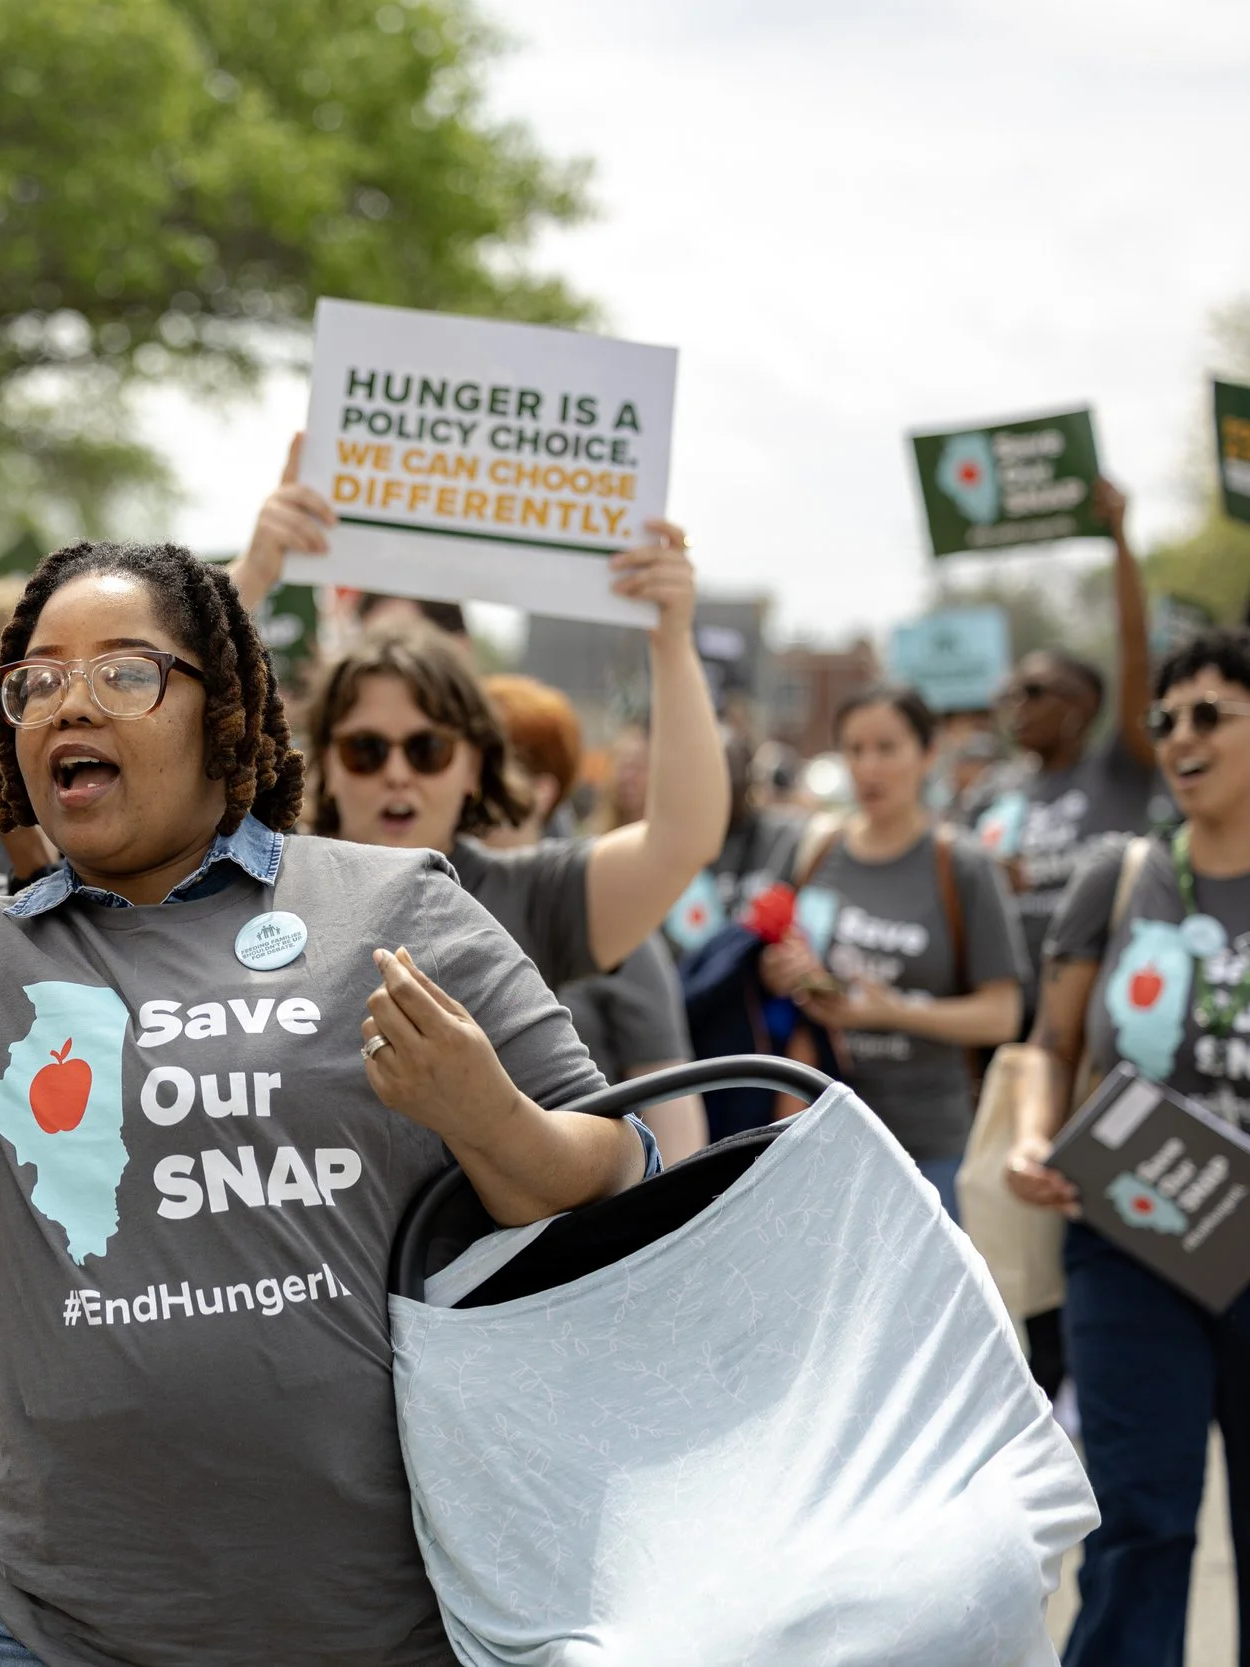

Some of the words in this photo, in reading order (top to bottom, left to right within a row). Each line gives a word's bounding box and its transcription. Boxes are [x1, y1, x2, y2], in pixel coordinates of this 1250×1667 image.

[346, 367, 541, 420] HUNGER
[559, 393, 598, 427] IS
[614, 402, 642, 433] A
[340, 407, 478, 446] POLICY
[488, 423, 638, 467] CHOICE.
[336, 440, 391, 471] WE
[402, 448, 478, 481] CAN
[488, 460, 637, 501] CHOOSE
[332, 475, 633, 538] DIFFERENTLY.
[241, 941, 270, 955] FEEDING
[270, 931, 302, 945] FAMILIES
[242, 942, 281, 959] SHOULDN'T
[251, 953, 266, 961] FOR
[136, 996, 321, 1048] Save
[140, 1066, 282, 1127] Our
[153, 1146, 362, 1220] SNAP
